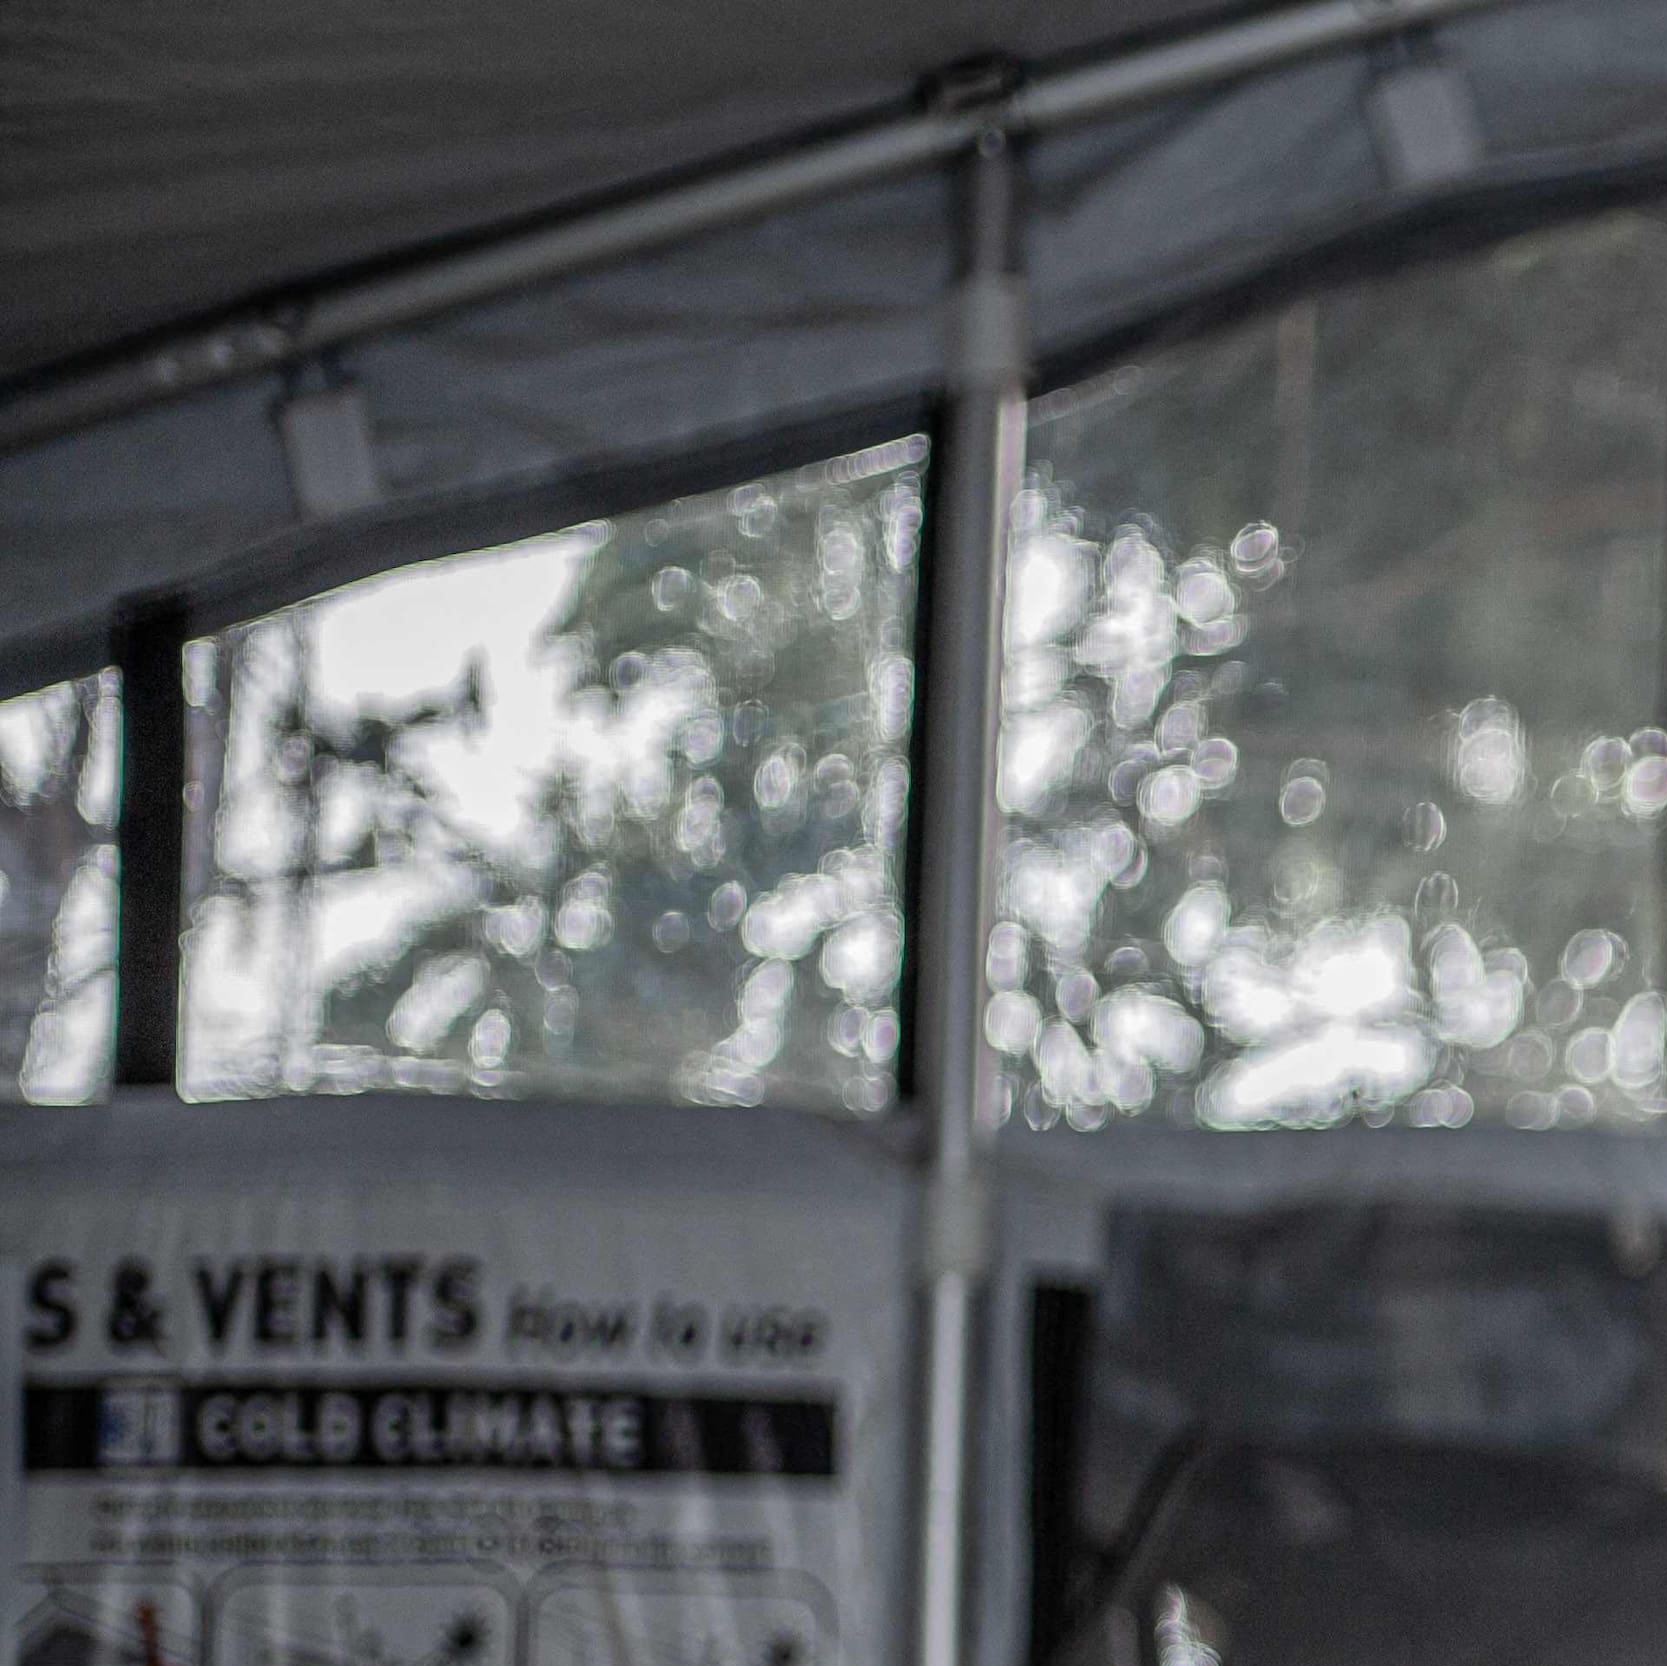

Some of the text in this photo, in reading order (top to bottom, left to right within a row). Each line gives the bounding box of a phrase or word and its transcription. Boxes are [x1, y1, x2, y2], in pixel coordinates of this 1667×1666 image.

[107, 1256, 166, 1352] &
[195, 1253, 483, 1352] VENTS
[505, 1283, 634, 1360] How
[648, 1290, 708, 1364] to
[719, 1300, 829, 1365] use
[200, 1392, 645, 1468] COLD CLIMATE
